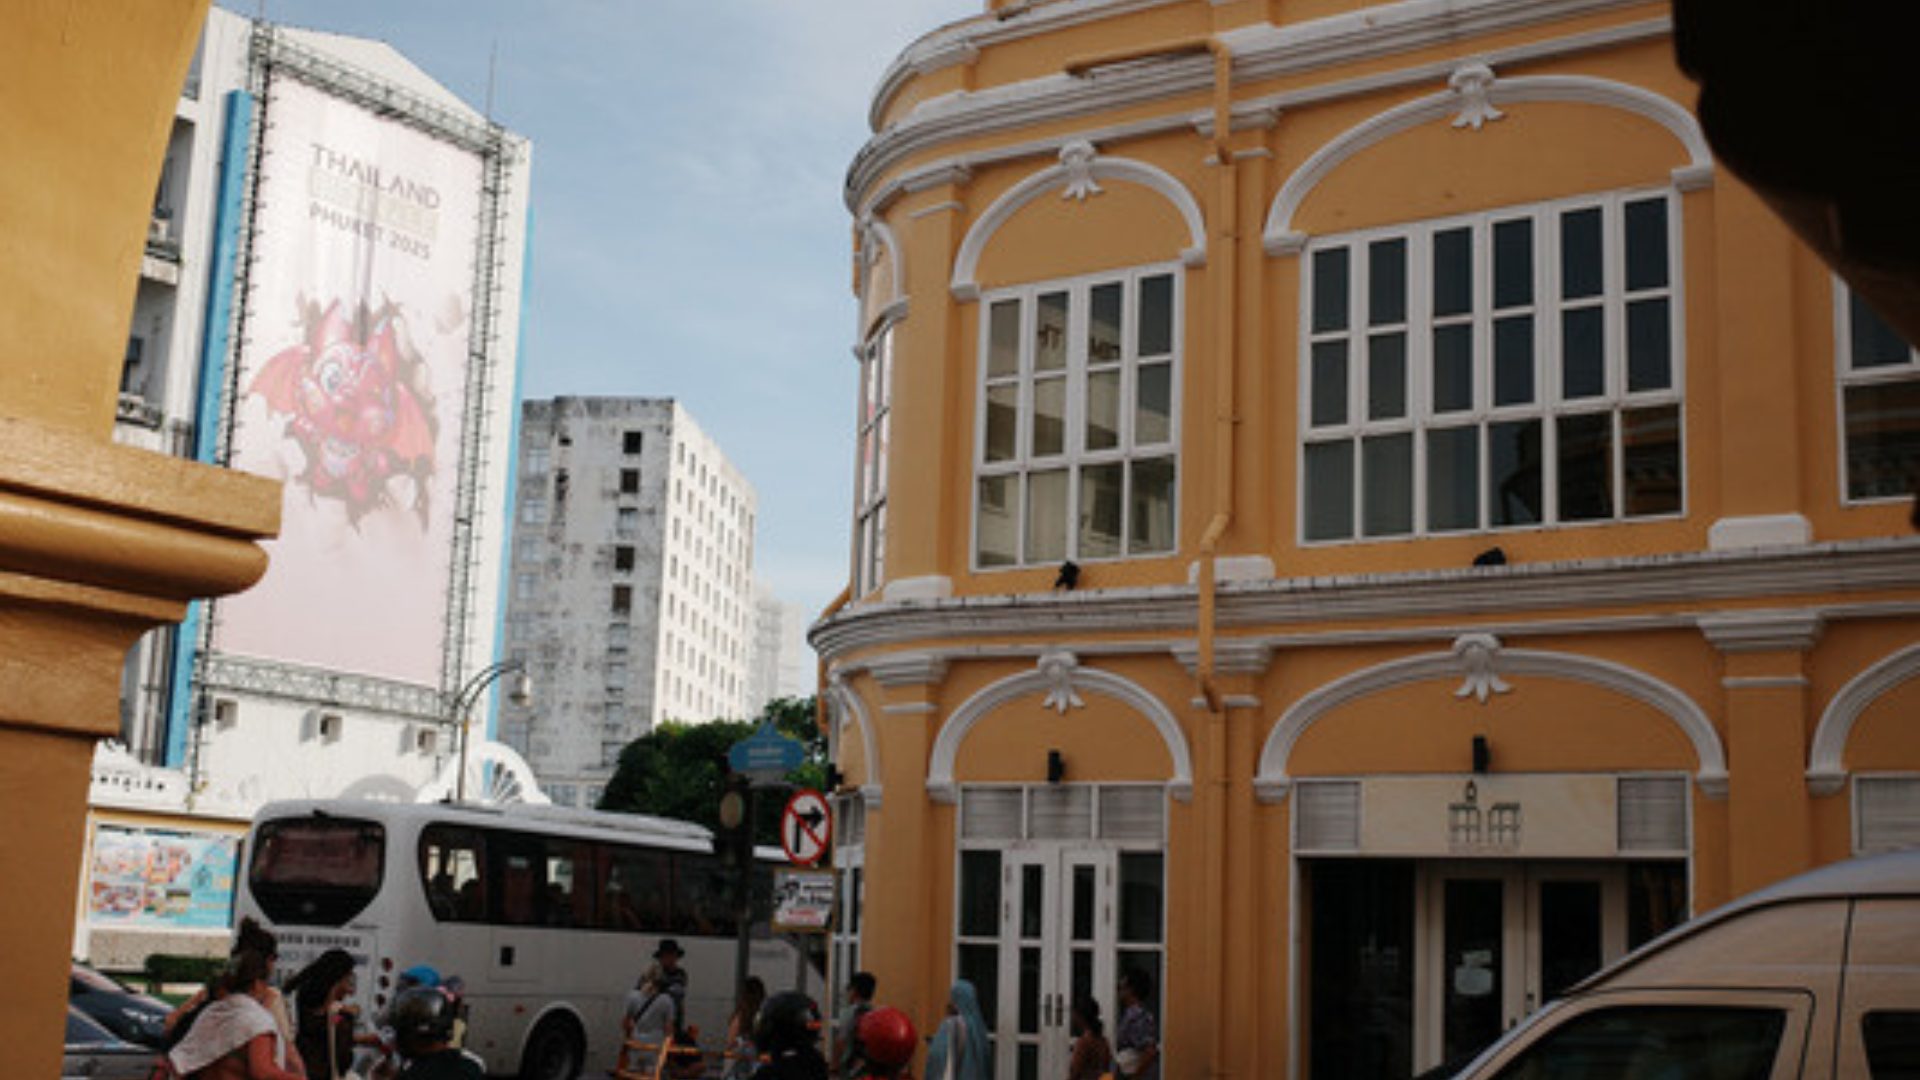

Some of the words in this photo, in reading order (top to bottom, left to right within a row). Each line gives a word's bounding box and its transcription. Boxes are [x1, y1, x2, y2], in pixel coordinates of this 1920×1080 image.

[310, 142, 441, 209] THAILAND
[309, 201, 384, 241] PHUKET
[389, 229, 430, 260] 2025
